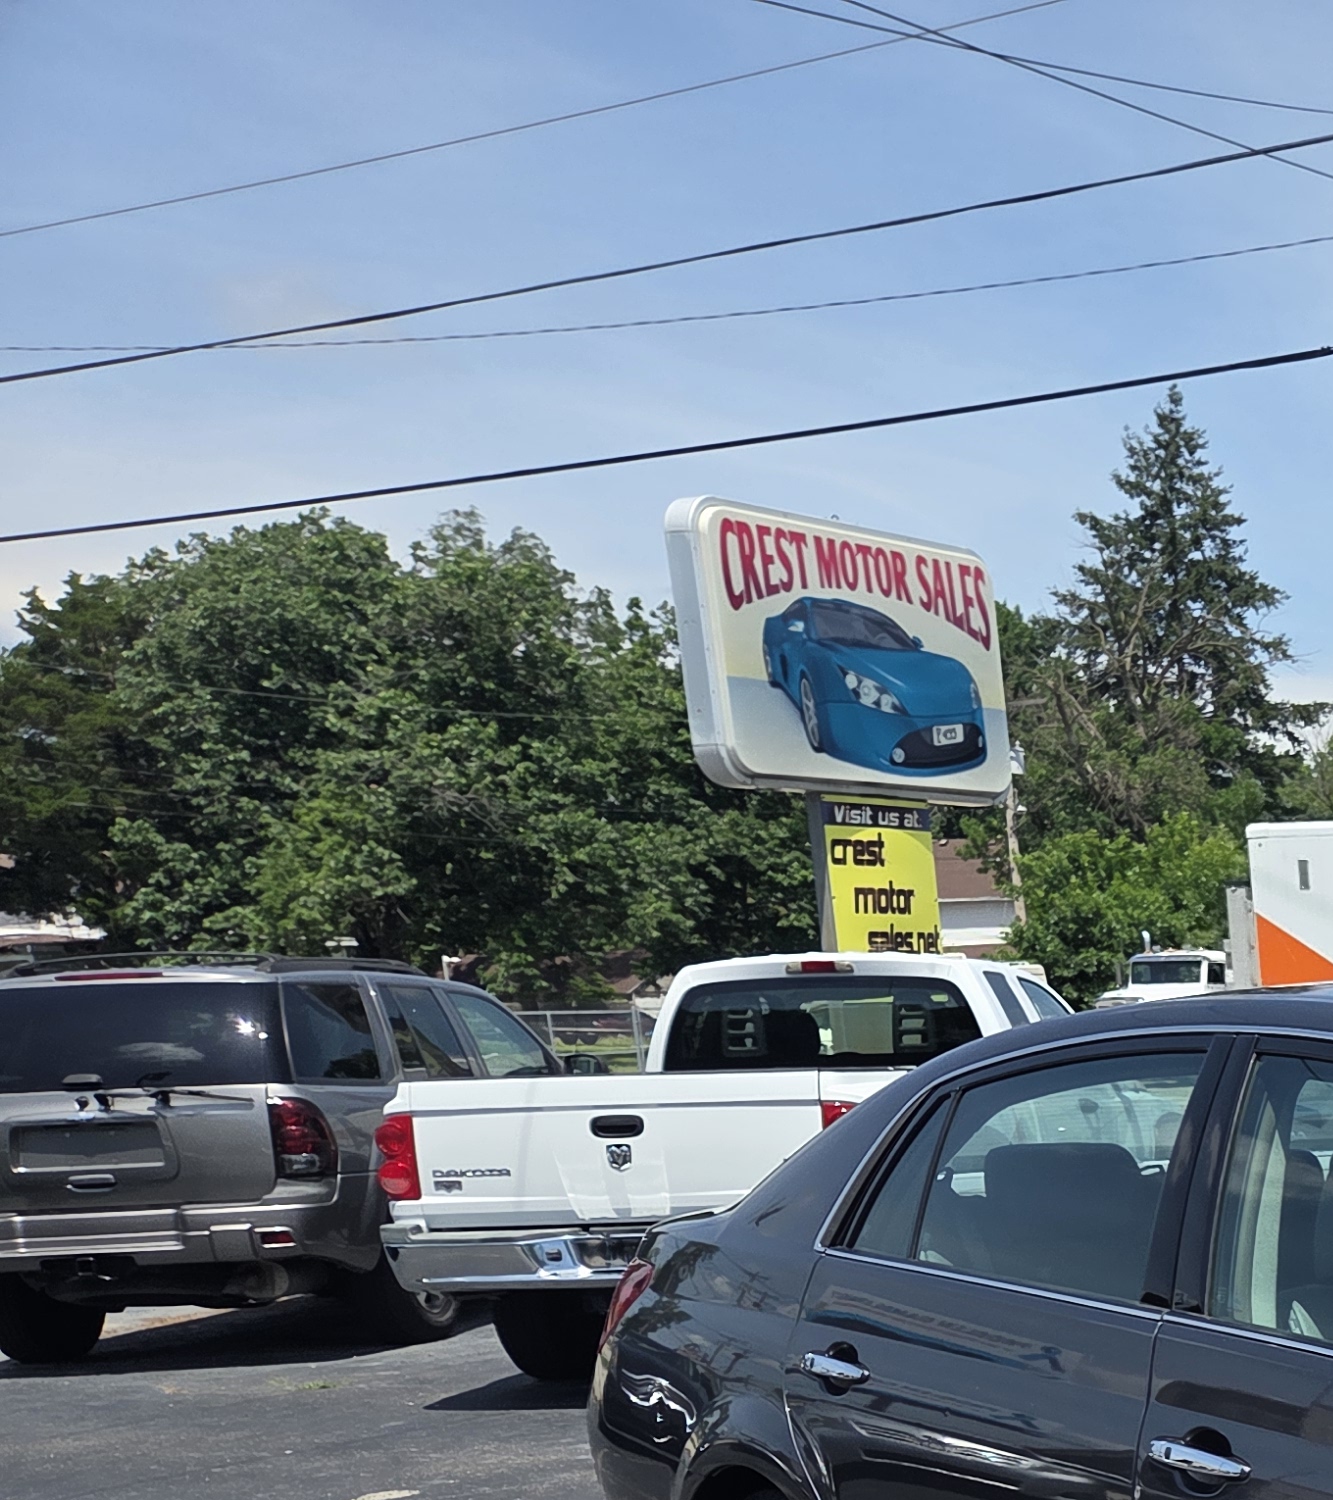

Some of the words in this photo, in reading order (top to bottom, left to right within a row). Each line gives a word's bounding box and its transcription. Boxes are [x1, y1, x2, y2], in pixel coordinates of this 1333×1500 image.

[720, 518, 808, 611] CREST
[813, 535, 913, 604] MOTOR
[916, 555, 990, 651] SALES
[834, 805, 873, 825] Visit
[878, 810, 900, 826] us
[831, 832, 885, 867] crest
[854, 880, 915, 915] motor
